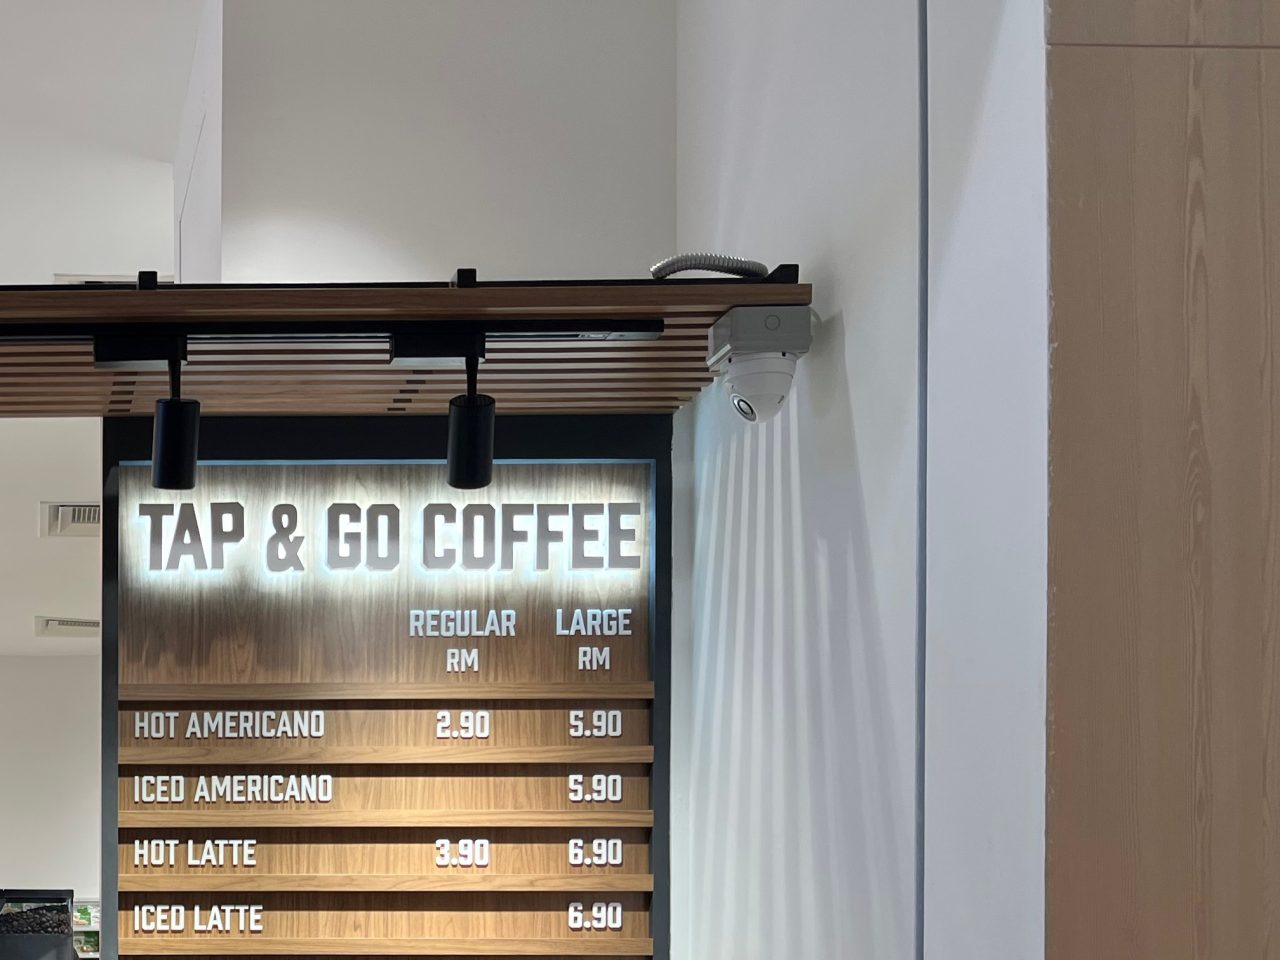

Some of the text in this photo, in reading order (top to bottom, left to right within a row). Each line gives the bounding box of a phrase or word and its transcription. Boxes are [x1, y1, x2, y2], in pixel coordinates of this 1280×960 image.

[139, 502, 641, 572] TAP & GO COFFEE
[409, 608, 632, 637] REGULAR LARGE
[446, 647, 610, 673] RM RM
[134, 710, 622, 739] HOT AMERICANO 2.90 5.90
[134, 774, 622, 804] ICED AMERICANO 5.90
[134, 838, 622, 867] HOT LATTE 3.90 6.90
[134, 902, 622, 933] ICED LATTE 6.90
